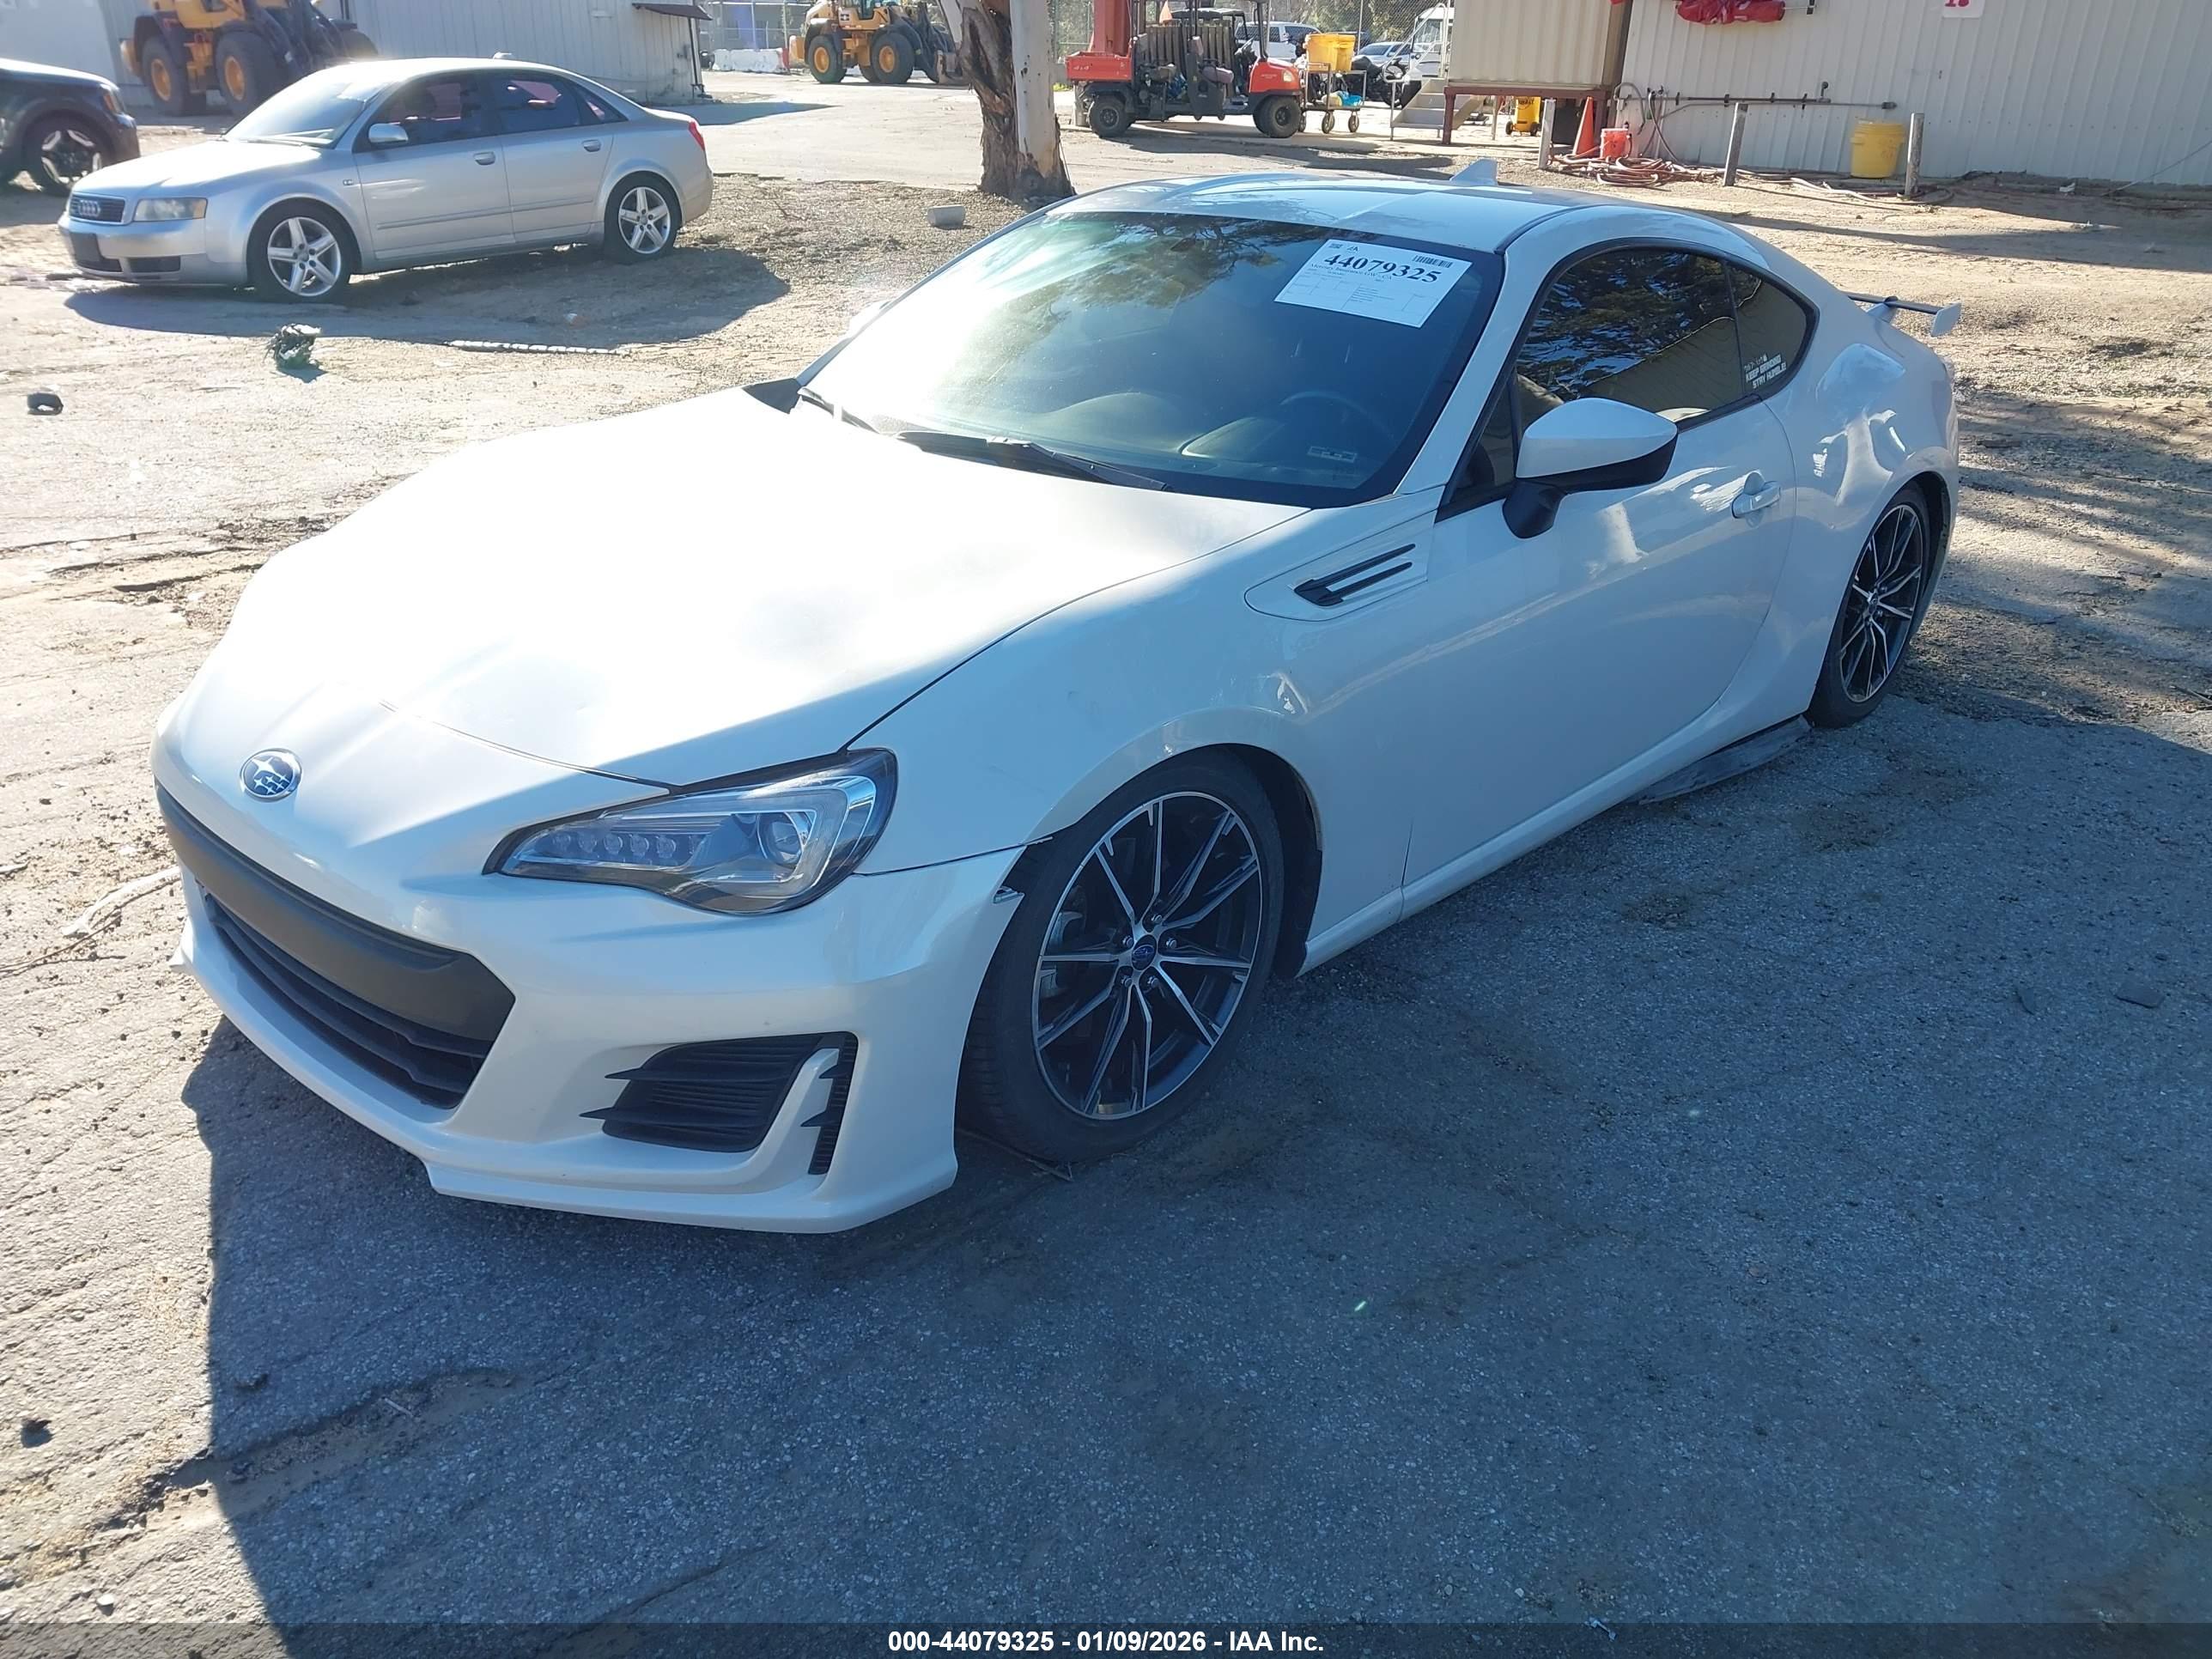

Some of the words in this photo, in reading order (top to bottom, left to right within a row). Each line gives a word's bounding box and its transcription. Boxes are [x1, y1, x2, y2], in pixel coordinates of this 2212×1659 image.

[1324, 254, 1442, 283] 44079325
[1745, 368, 1759, 383] KEEP
[1752, 374, 1766, 389] STAY
